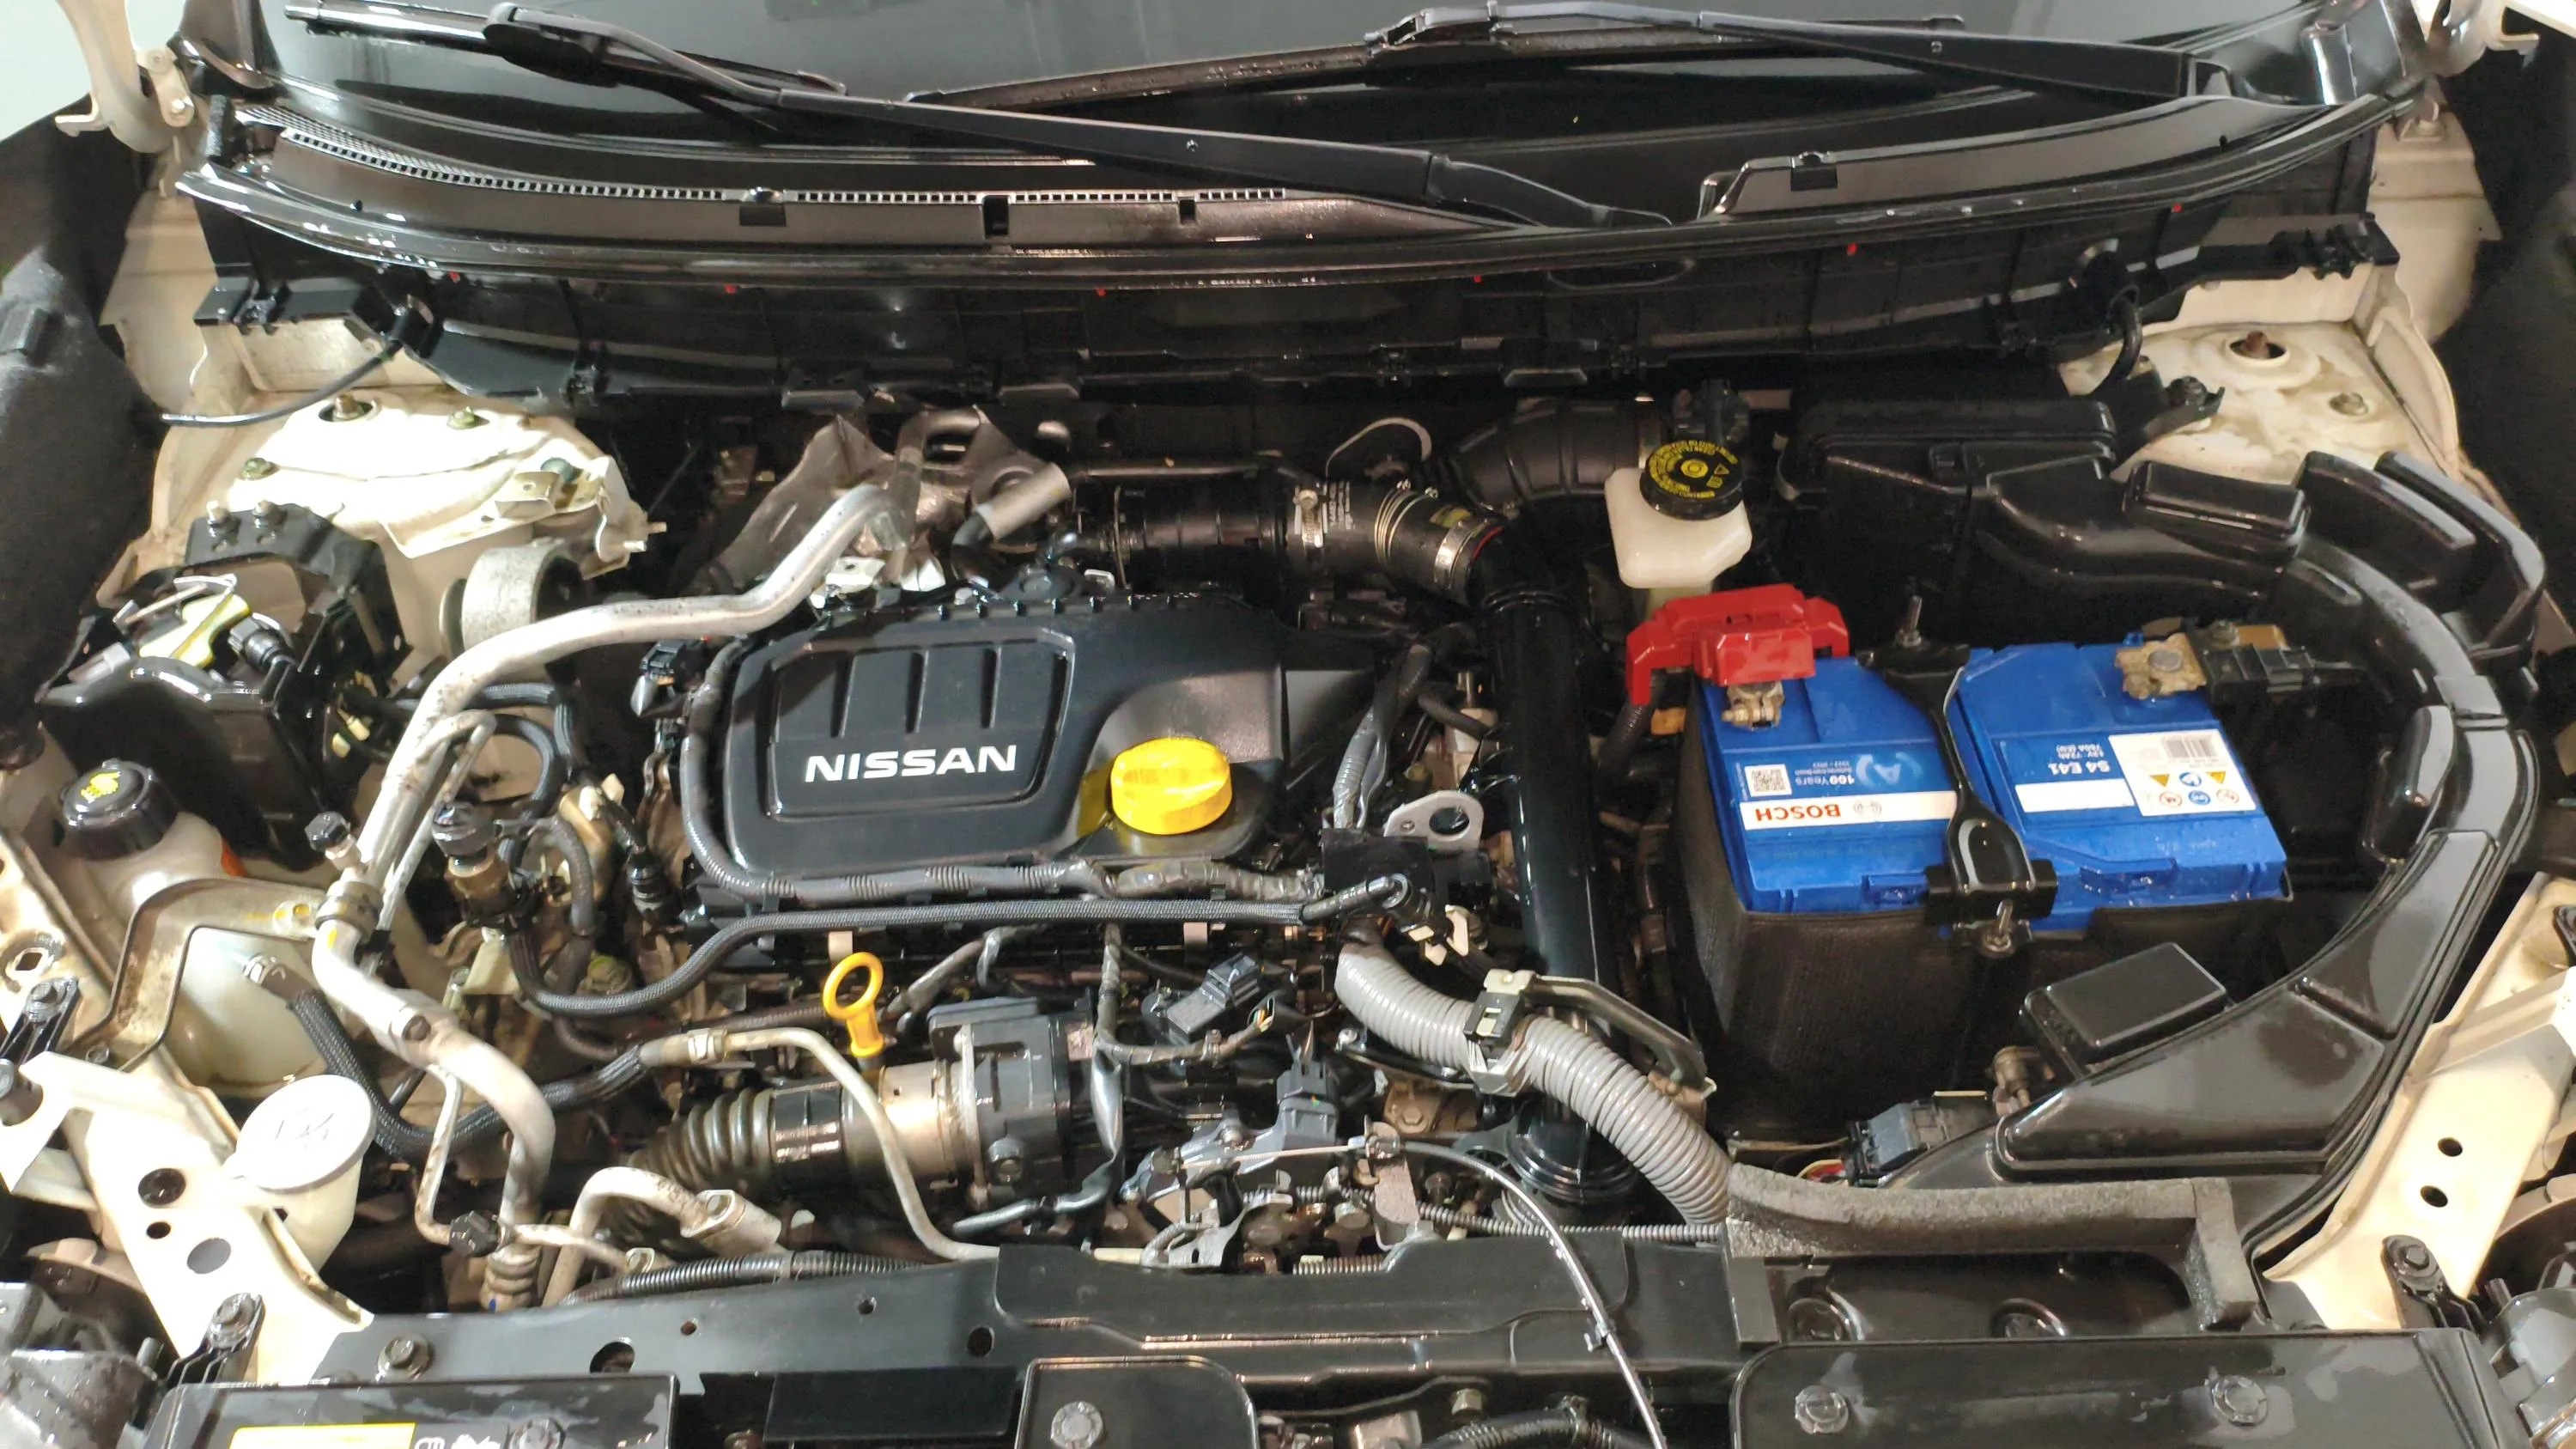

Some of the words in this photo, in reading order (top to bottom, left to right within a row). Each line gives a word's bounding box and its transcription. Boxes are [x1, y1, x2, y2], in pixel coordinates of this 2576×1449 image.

[804, 745, 1018, 783] NISSAN
[2048, 761, 2082, 776] E41
[2086, 760, 2110, 774] S4
[1795, 776, 1829, 786] Years
[1830, 774, 1855, 785] 100
[1755, 804, 1841, 822] BOSCH
